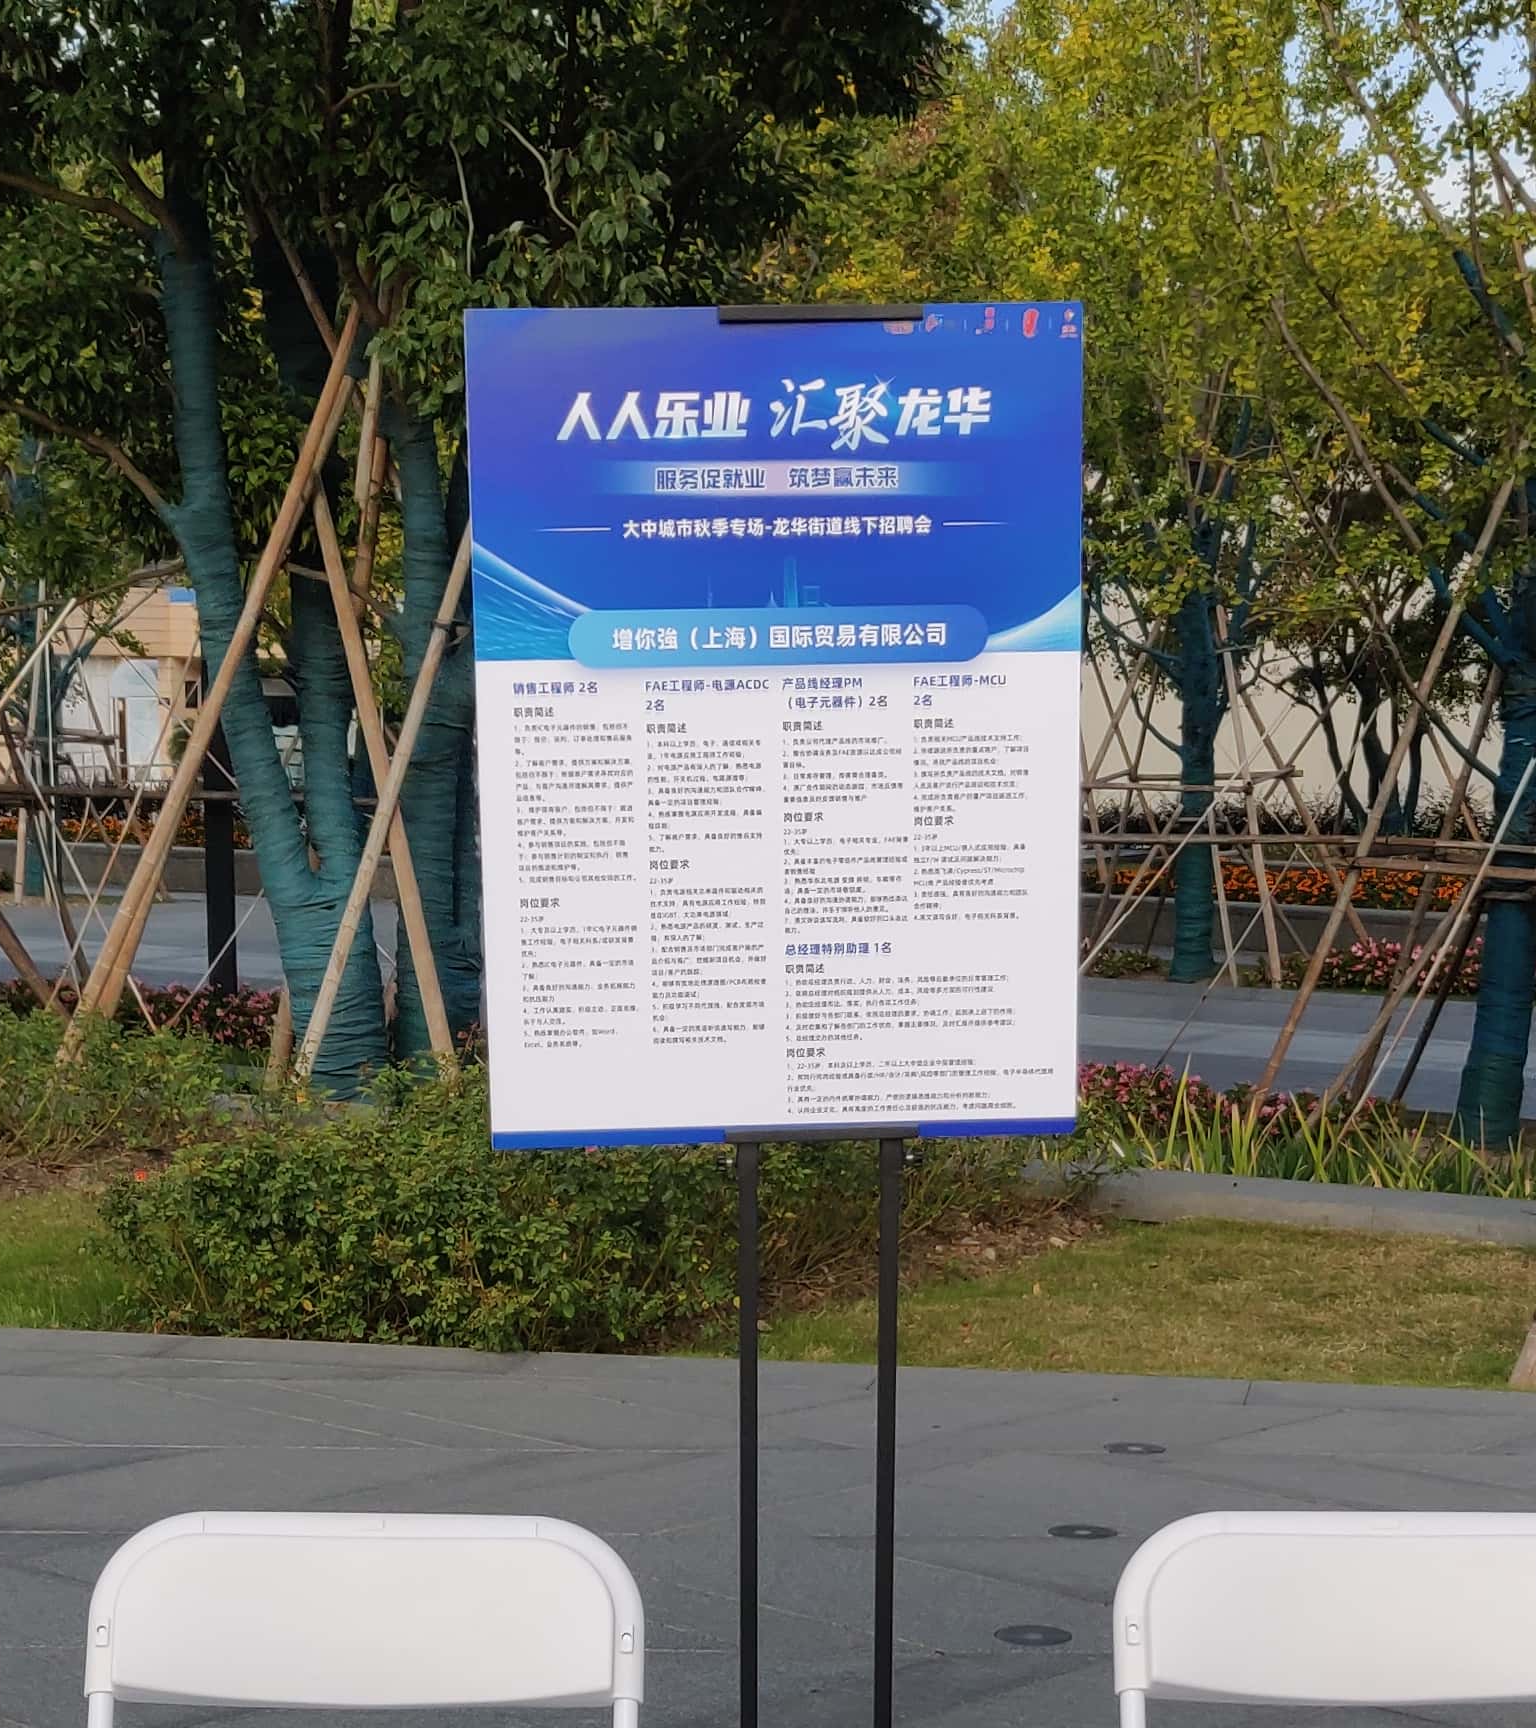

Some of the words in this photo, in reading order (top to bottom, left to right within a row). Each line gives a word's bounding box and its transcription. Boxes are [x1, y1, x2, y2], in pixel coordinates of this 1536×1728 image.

[556, 390, 750, 442] 人人乐业
[769, 377, 992, 452] 汇聚龙华
[655, 467, 766, 491] 服务促就业
[787, 466, 900, 489] 筑梦赢未来
[622, 515, 933, 539] 大中城市秋季专场-龙华街道线下招聘会
[644, 679, 770, 694] FAE工程师-电源ACDC
[781, 677, 863, 690] 产品线经理PM
[913, 675, 1007, 688] FAE工程师-MCU
[513, 682, 575, 695] 销售工程师
[578, 681, 599, 694] 2名
[645, 699, 665, 712] 2名
[913, 694, 933, 707] 2名
[513, 707, 555, 718] 职责简述
[646, 723, 687, 734] 职责简述
[782, 721, 823, 732] 职责简述
[913, 718, 954, 730] 职责简述
[783, 811, 824, 823] 岗位要求
[913, 815, 954, 827] 岗位要求
[649, 859, 690, 871] 岗位要求
[519, 898, 561, 909] 岗位要求
[784, 942, 870, 956] 总经理特别助理
[874, 941, 892, 954] 1名
[784, 963, 825, 974] 职责简述
[786, 1047, 827, 1058] 岗位要求
